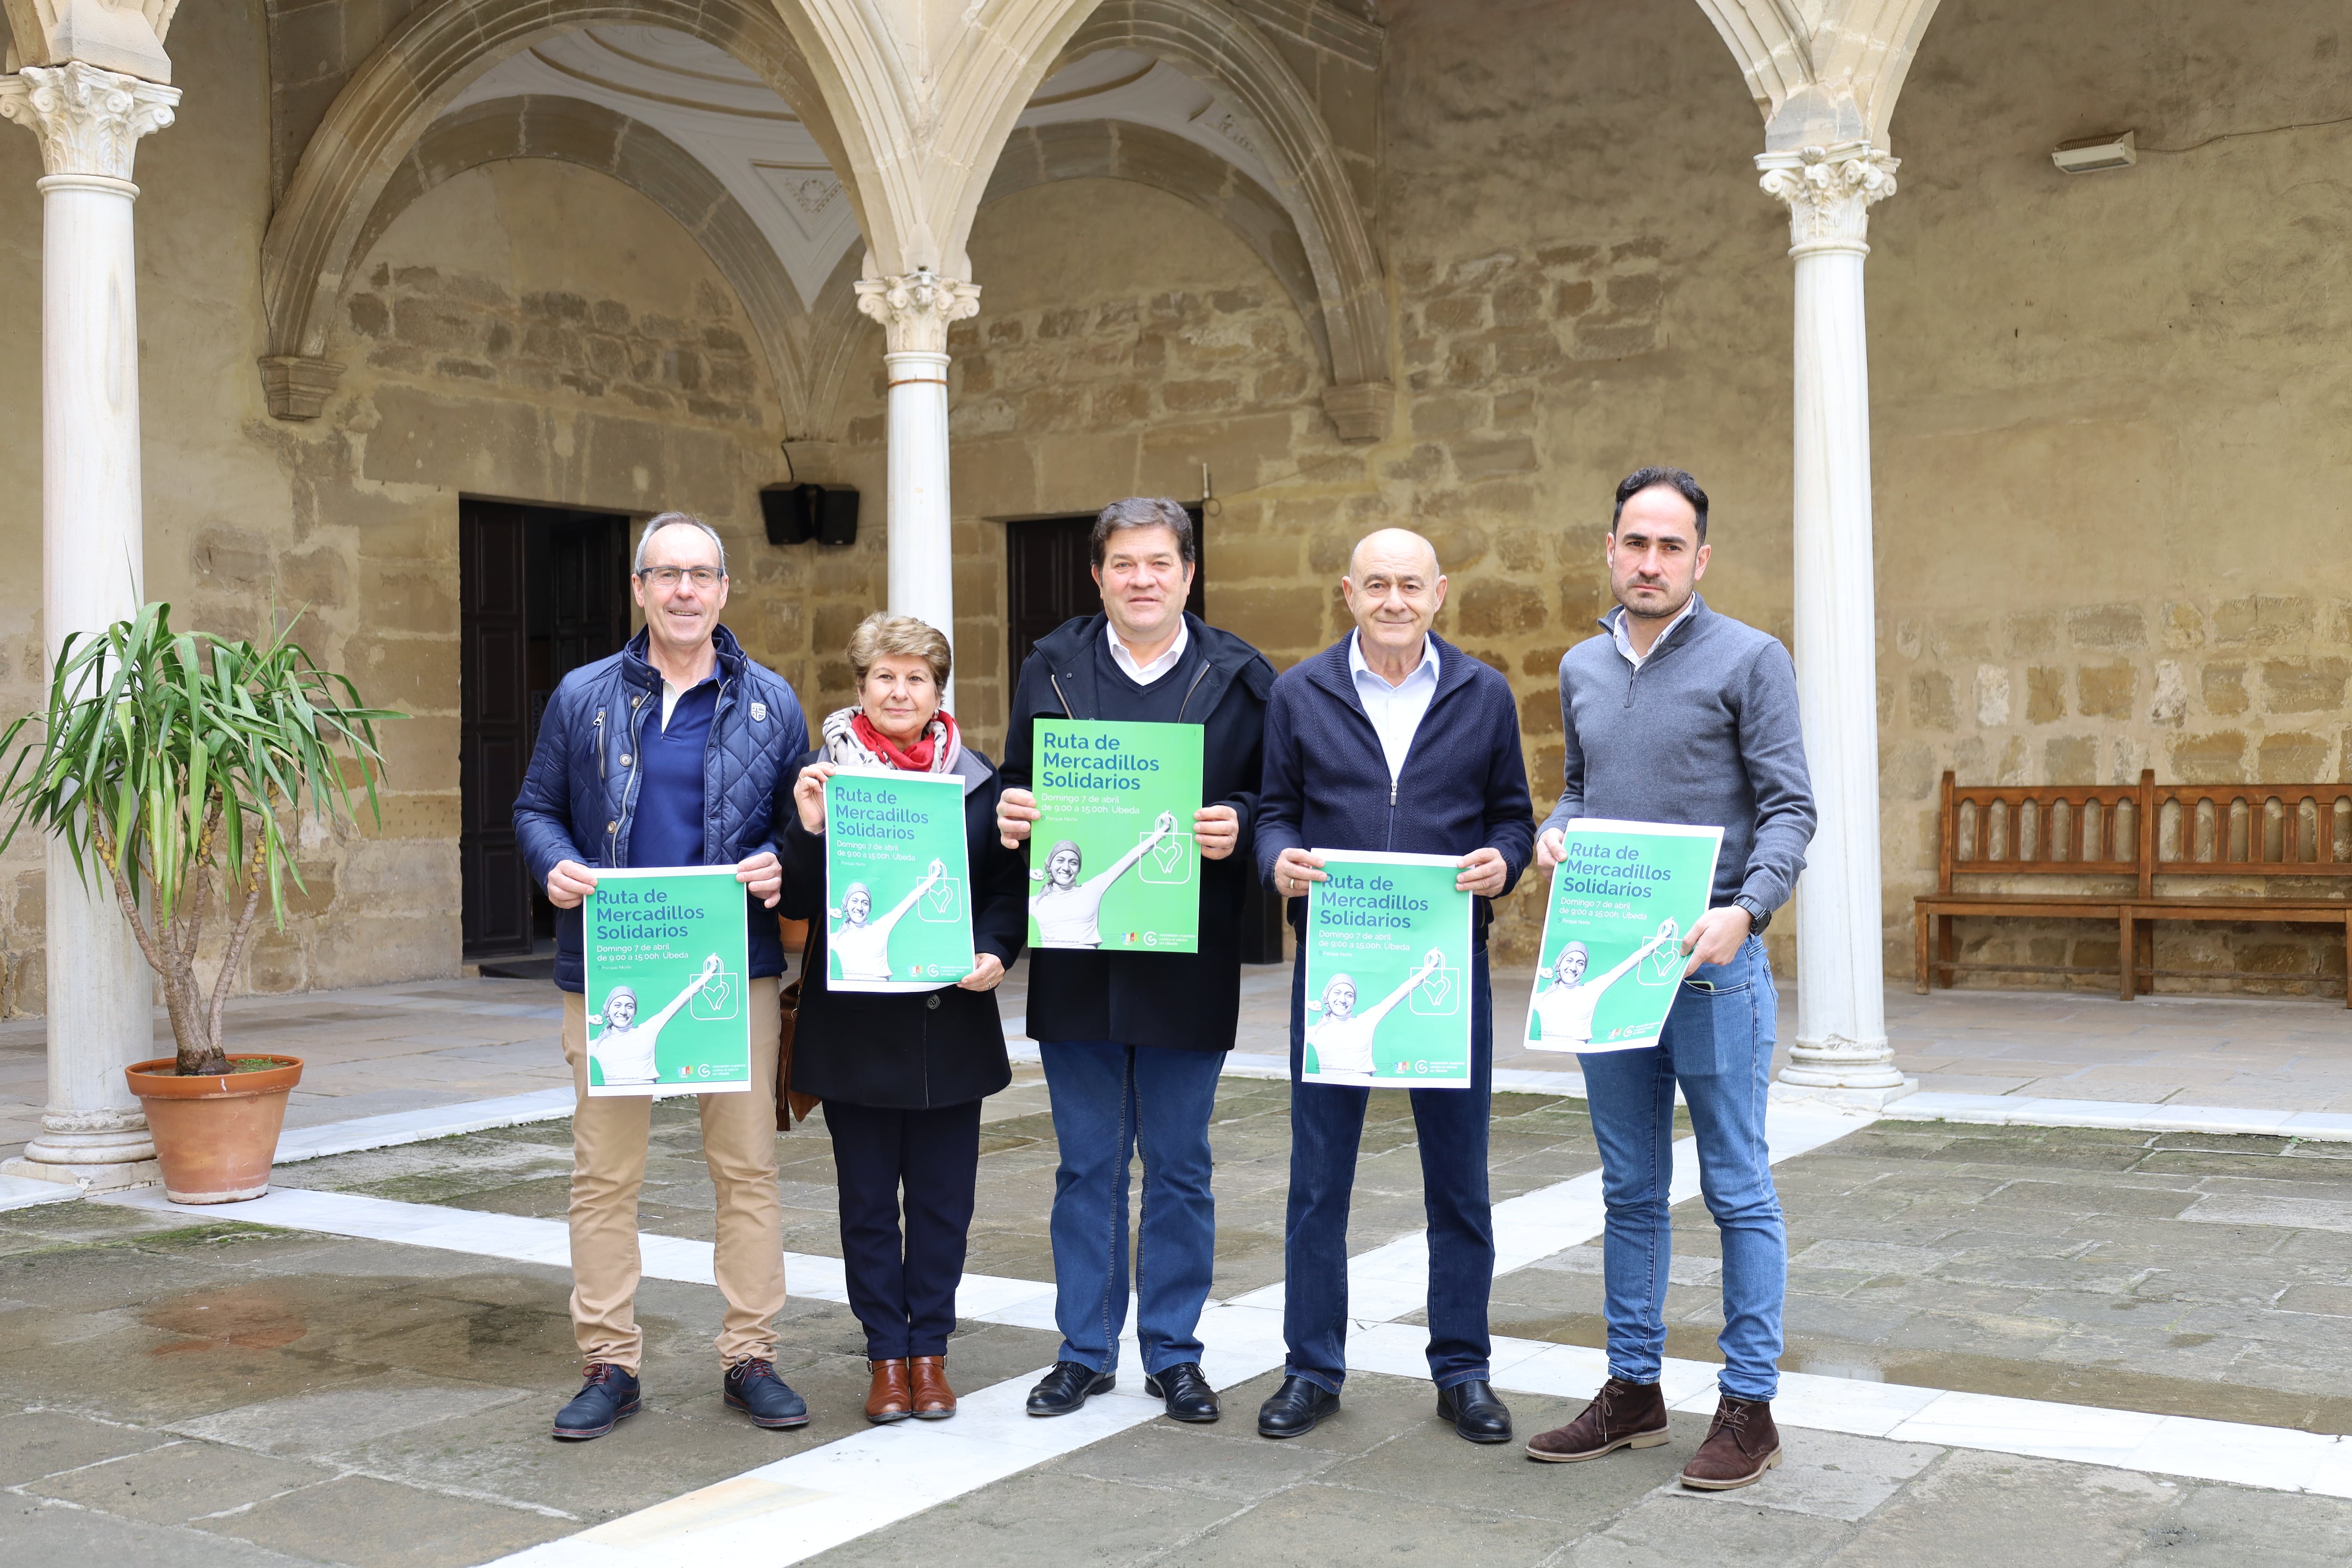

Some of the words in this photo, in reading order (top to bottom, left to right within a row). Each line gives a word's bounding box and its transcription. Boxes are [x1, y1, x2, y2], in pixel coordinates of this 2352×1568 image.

[1044, 732, 1089, 749] Ruta
[1095, 734, 1120, 750] de
[1044, 752, 1159, 771] Mercadillos
[1043, 772, 1140, 790] Solidarios
[836, 787, 872, 803] Ruta
[877, 790, 897, 804] de
[1041, 793, 1080, 803] Domingo
[836, 804, 928, 823] Mercadillos
[837, 821, 914, 839] Solidarios
[837, 840, 866, 850] Domingo
[1570, 843, 1610, 858] Ruta
[1616, 845, 1639, 860] de
[1566, 860, 1671, 881] Mercadillos
[1323, 874, 1364, 889] Ruta
[1370, 876, 1393, 891] de
[1563, 877, 1652, 898] Solidarios
[597, 890, 638, 904] Ruta
[644, 889, 667, 903] de
[1322, 892, 1428, 911] Mercadillos
[1561, 897, 1595, 908] Domingo
[597, 906, 704, 922] Mercadillos
[1320, 910, 1410, 928] Solidarios
[597, 923, 688, 939] Solidarios
[1319, 930, 1354, 940] Domingo
